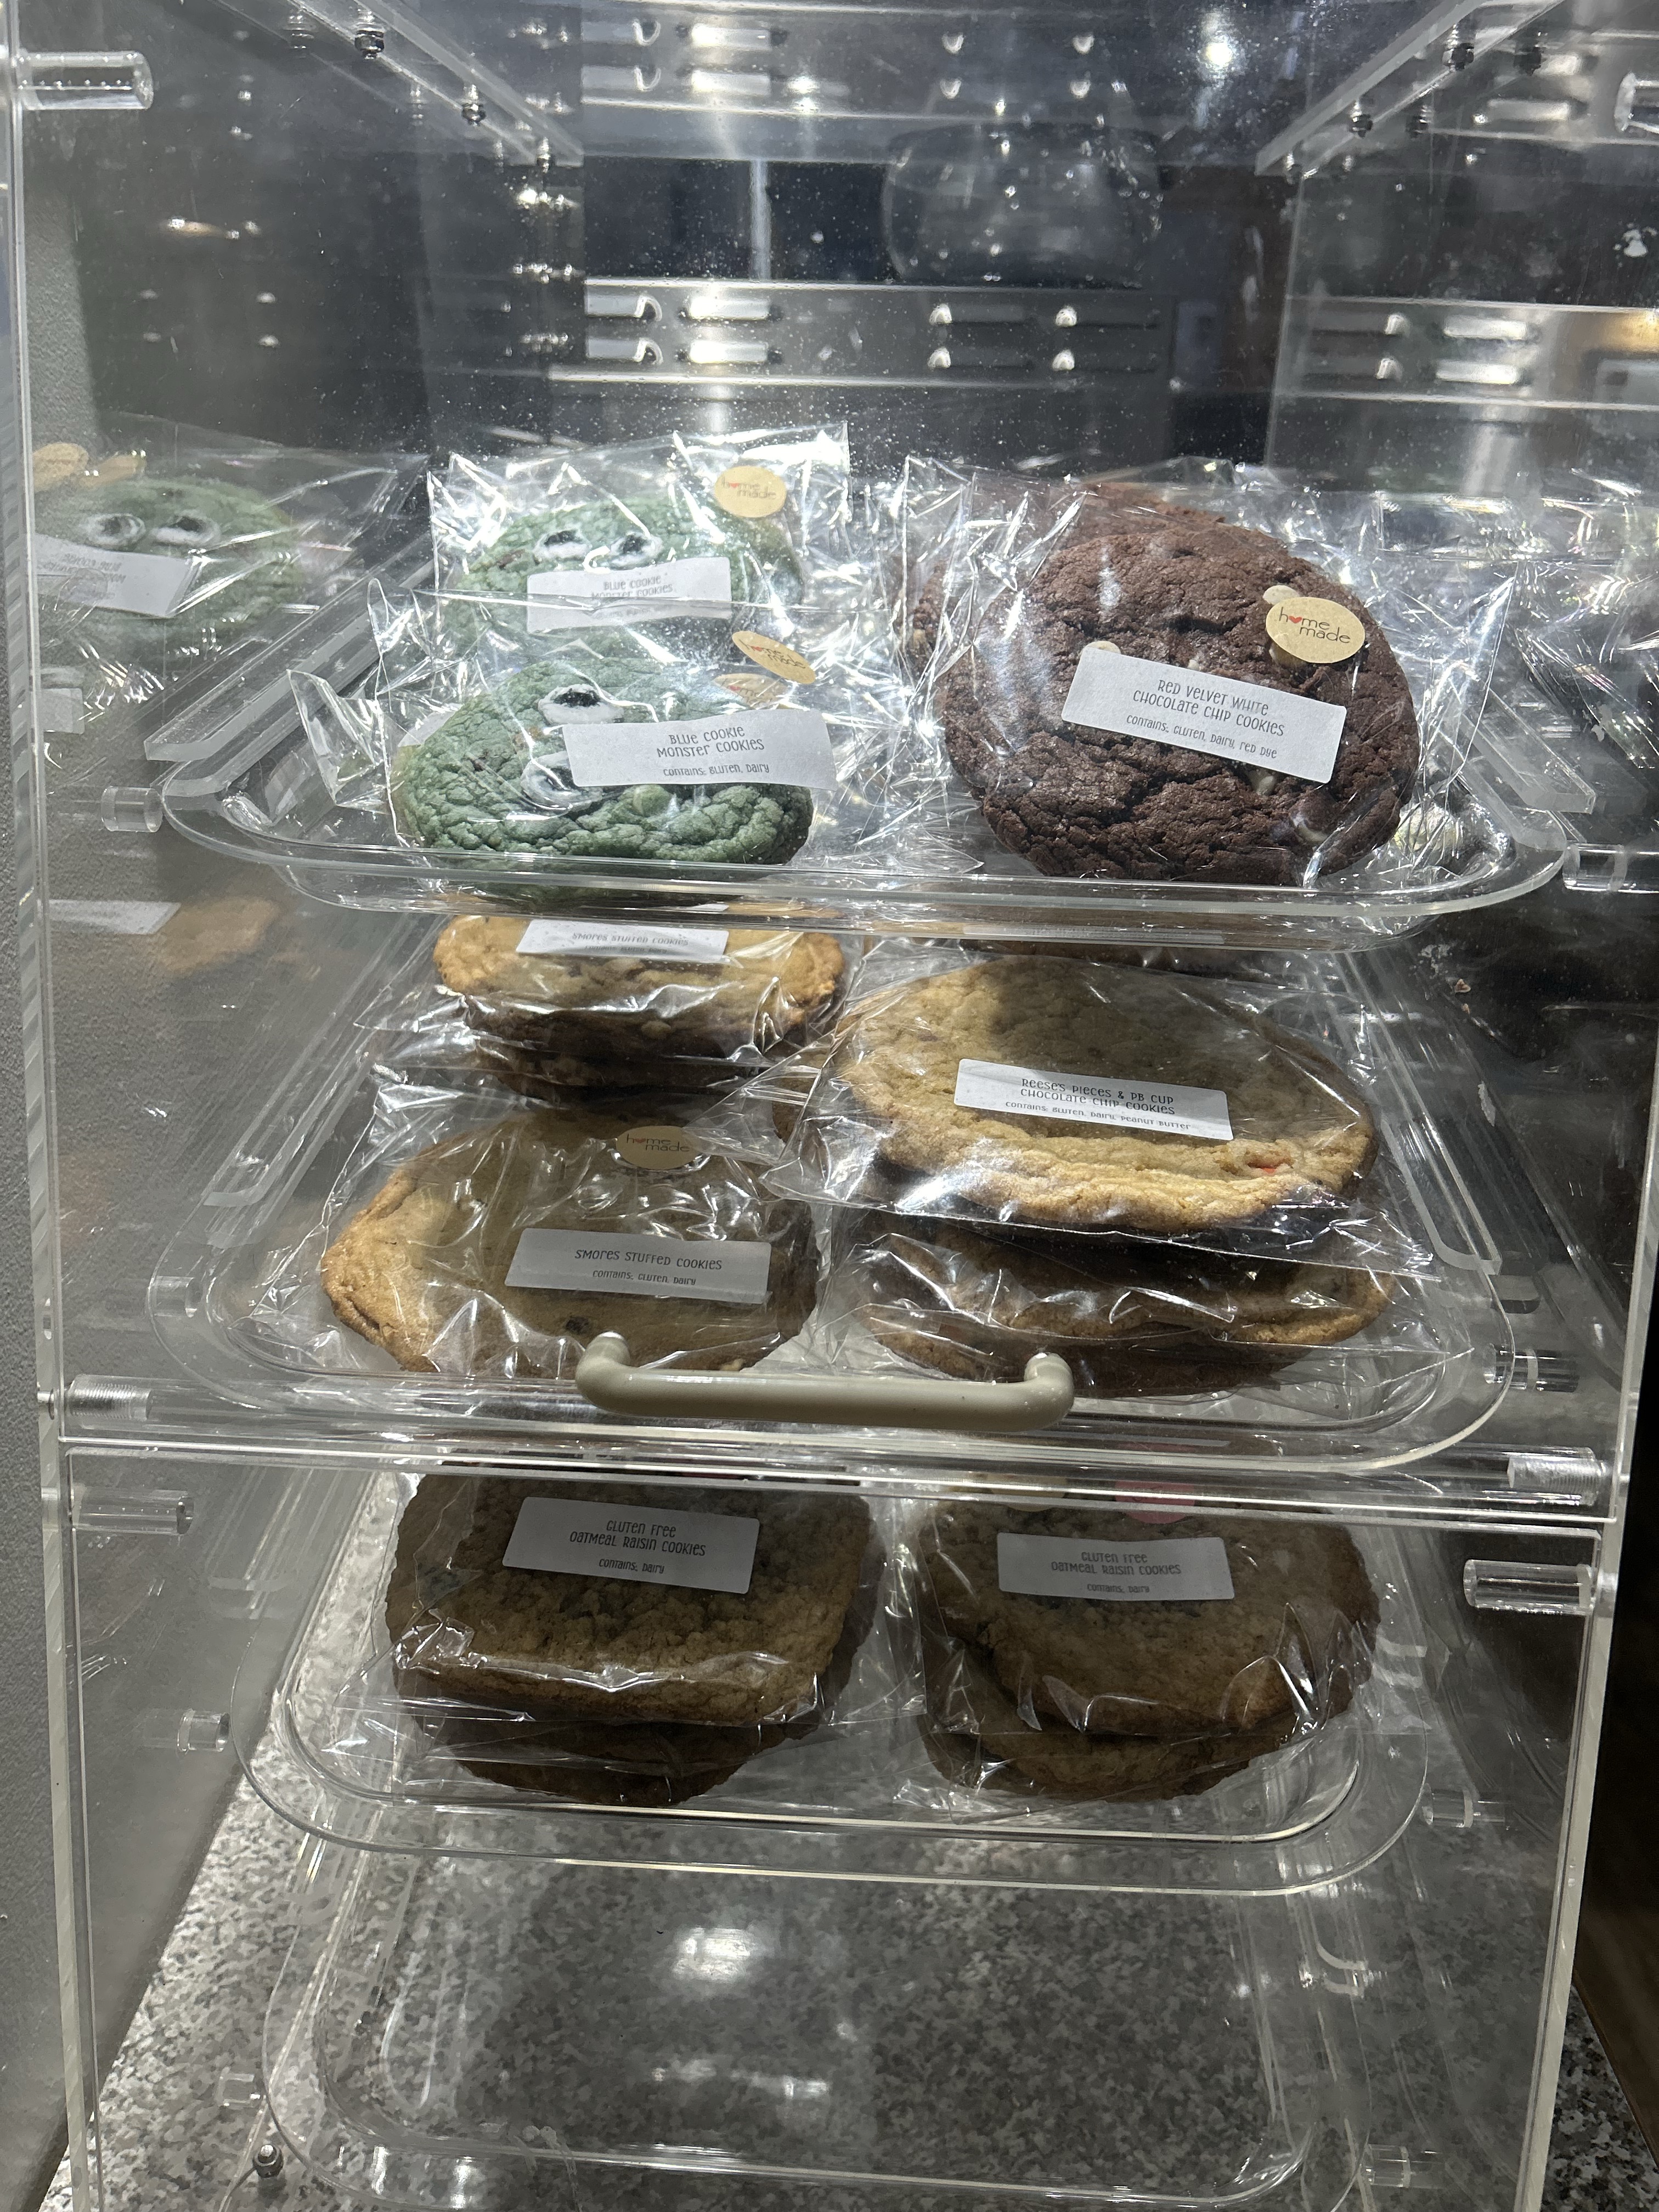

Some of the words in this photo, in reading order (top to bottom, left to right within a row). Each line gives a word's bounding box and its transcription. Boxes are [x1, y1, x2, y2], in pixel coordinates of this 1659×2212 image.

[737, 486, 776, 499] made
[1299, 627, 1351, 644] made
[767, 653, 806, 669] made
[1118, 1091, 1125, 1099] &
[1130, 1092, 1144, 1102] PB
[1150, 1094, 1174, 1105] CUP
[646, 1142, 690, 1152] made
